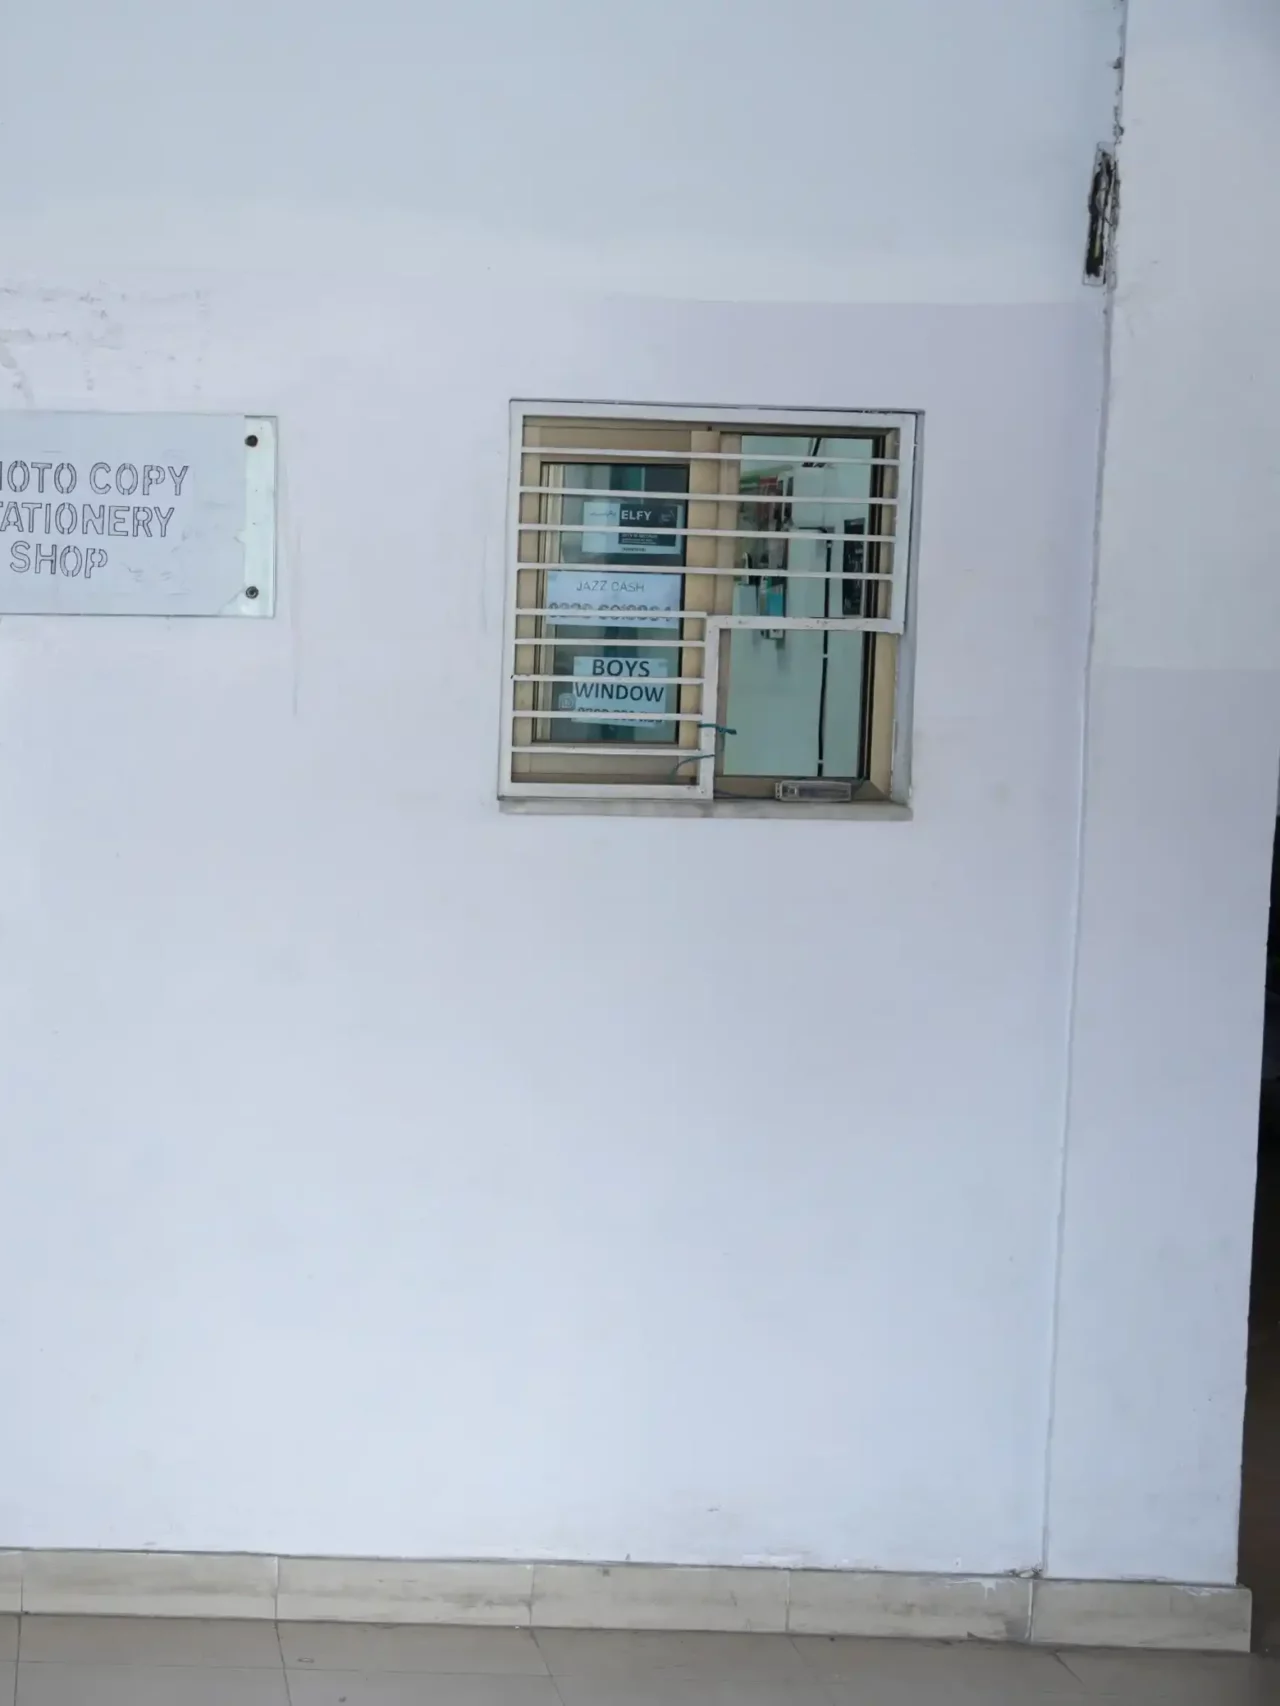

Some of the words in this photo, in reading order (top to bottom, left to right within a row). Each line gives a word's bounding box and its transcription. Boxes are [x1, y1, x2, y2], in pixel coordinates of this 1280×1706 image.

[89, 462, 189, 496] COPY
[621, 510, 652, 521] ELFY
[10, 541, 109, 579] SHOP
[576, 580, 608, 592] JAZZ
[611, 581, 645, 593] CASH
[592, 659, 651, 678] BOYS
[575, 683, 665, 703] WINDOW
